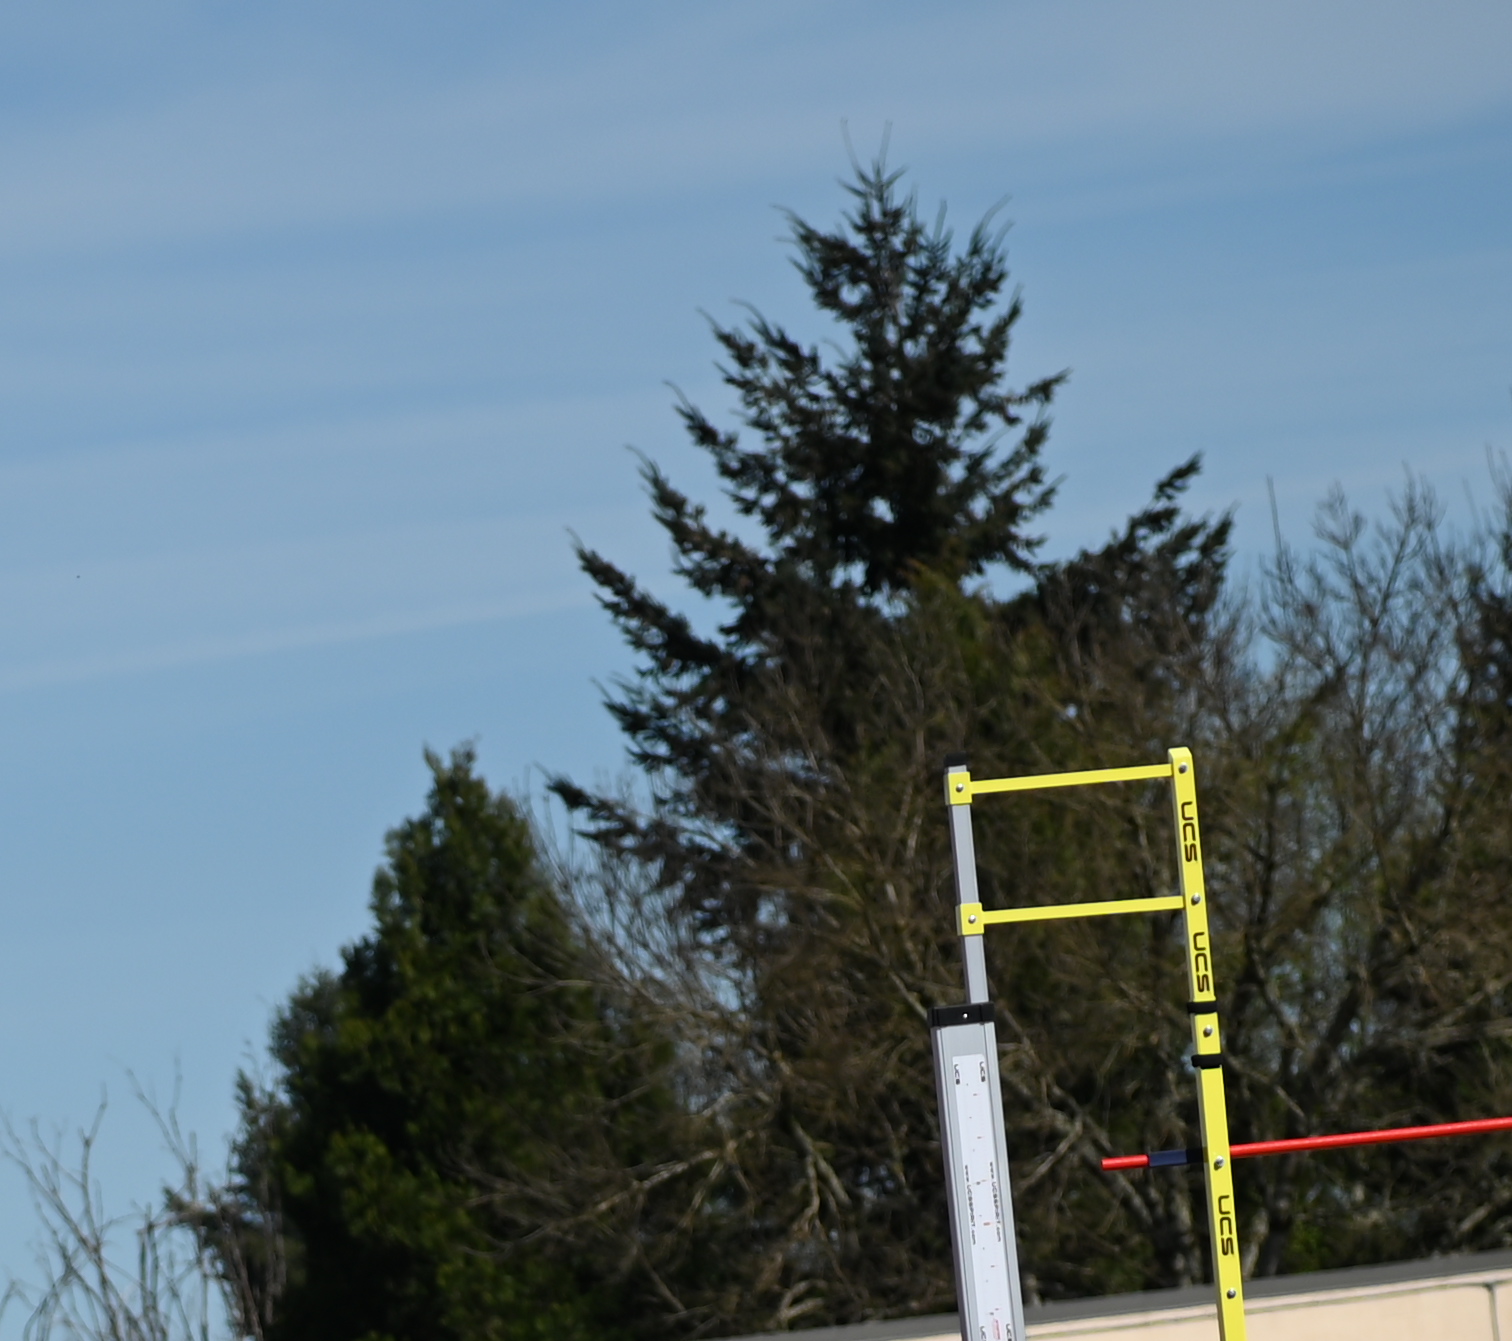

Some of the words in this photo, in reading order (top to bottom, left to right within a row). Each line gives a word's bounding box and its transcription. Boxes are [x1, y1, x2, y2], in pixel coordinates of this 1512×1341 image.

[1181, 800, 1198, 863] UCS
[1193, 932, 1210, 993] UCS
[1217, 1195, 1234, 1256] UCS
